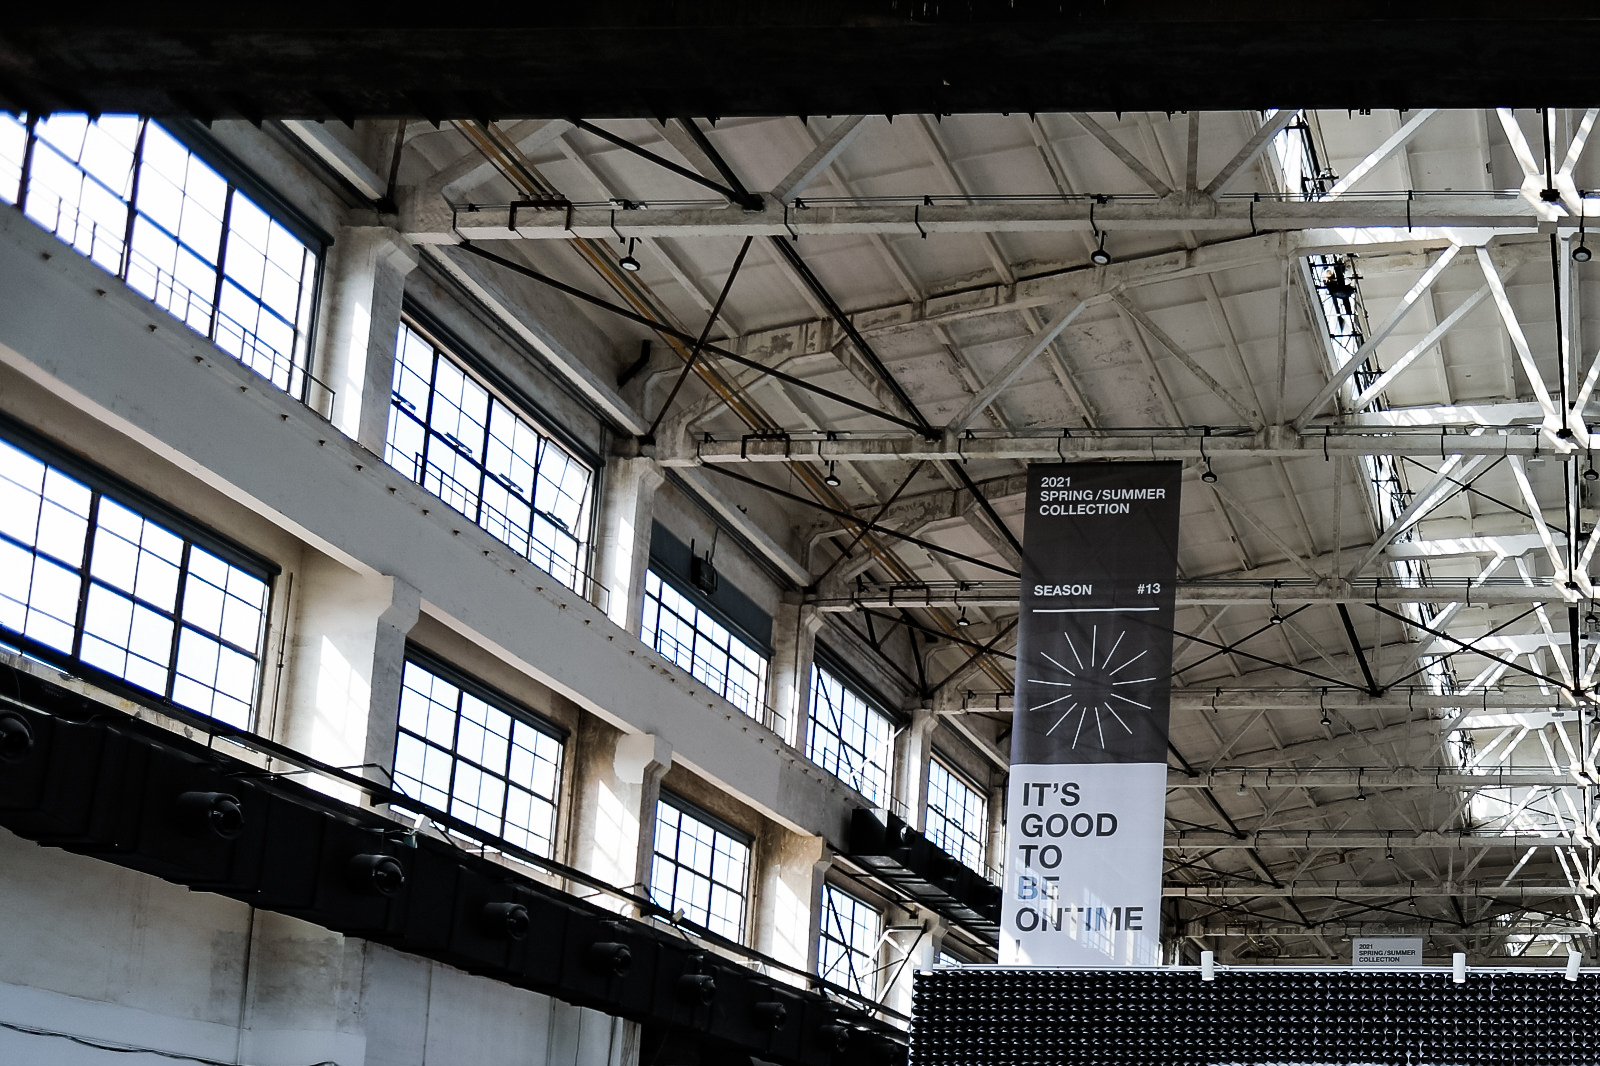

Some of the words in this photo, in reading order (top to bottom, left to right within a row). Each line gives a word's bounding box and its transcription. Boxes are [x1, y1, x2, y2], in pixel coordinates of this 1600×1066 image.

[1041, 477, 1071, 488] 2021
[1040, 490, 1093, 502] SPRING
[1039, 503, 1130, 516] COLLECTION
[1033, 584, 1093, 597] SEASON
[1137, 583, 1161, 595] #13
[1020, 813, 1118, 838] GOOD
[1018, 844, 1063, 869] TO
[1017, 876, 1060, 901] BE
[1015, 939, 1021, 963] !
